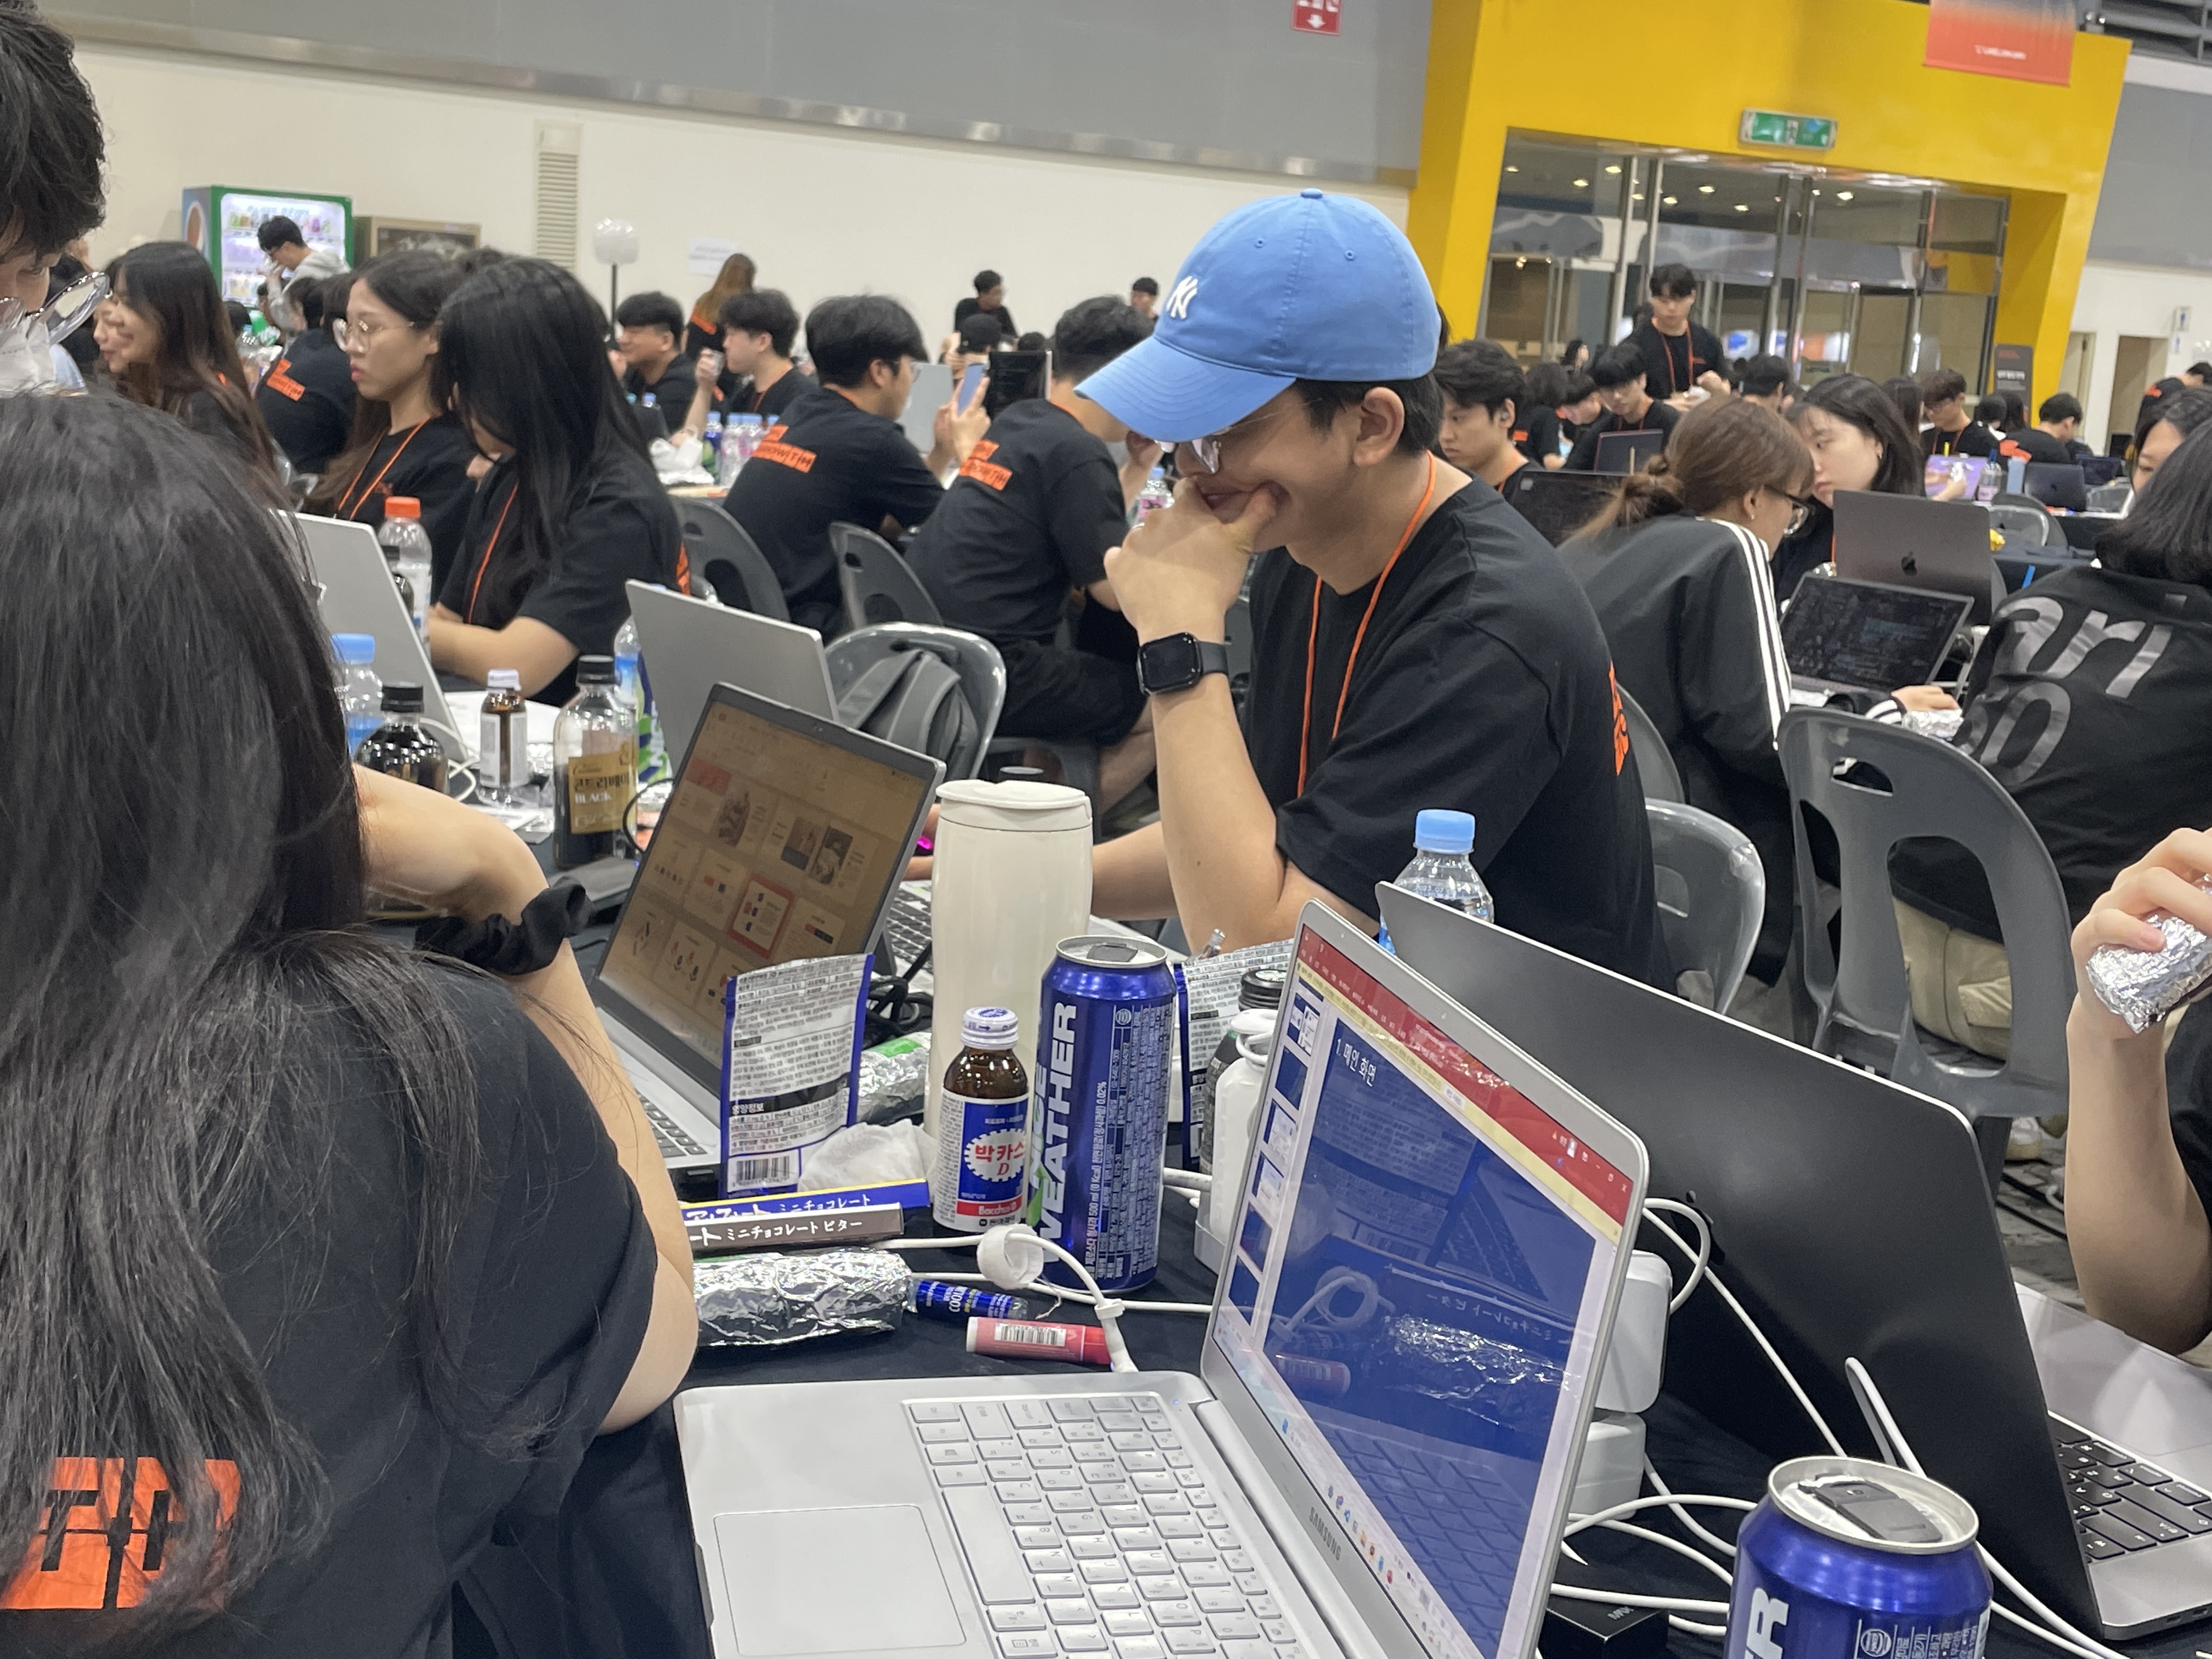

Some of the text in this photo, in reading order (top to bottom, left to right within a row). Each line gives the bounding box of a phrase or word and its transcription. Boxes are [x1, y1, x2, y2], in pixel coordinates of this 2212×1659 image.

[1342, 1043, 1360, 1072] 메인
[1358, 1057, 1377, 1087] 화면
[975, 1142, 1024, 1162] 박카스
[1039, 1002, 1077, 1263] WEATHER
[1088, 1203, 1099, 1217] 500
[1096, 1081, 1108, 1104] 0.02%
[996, 1163, 1009, 1176] D
[727, 1221, 819, 1241] ミニチョコレート
[823, 1219, 862, 1232] ビター
[1309, 1506, 1341, 1561] SAMSUNG
